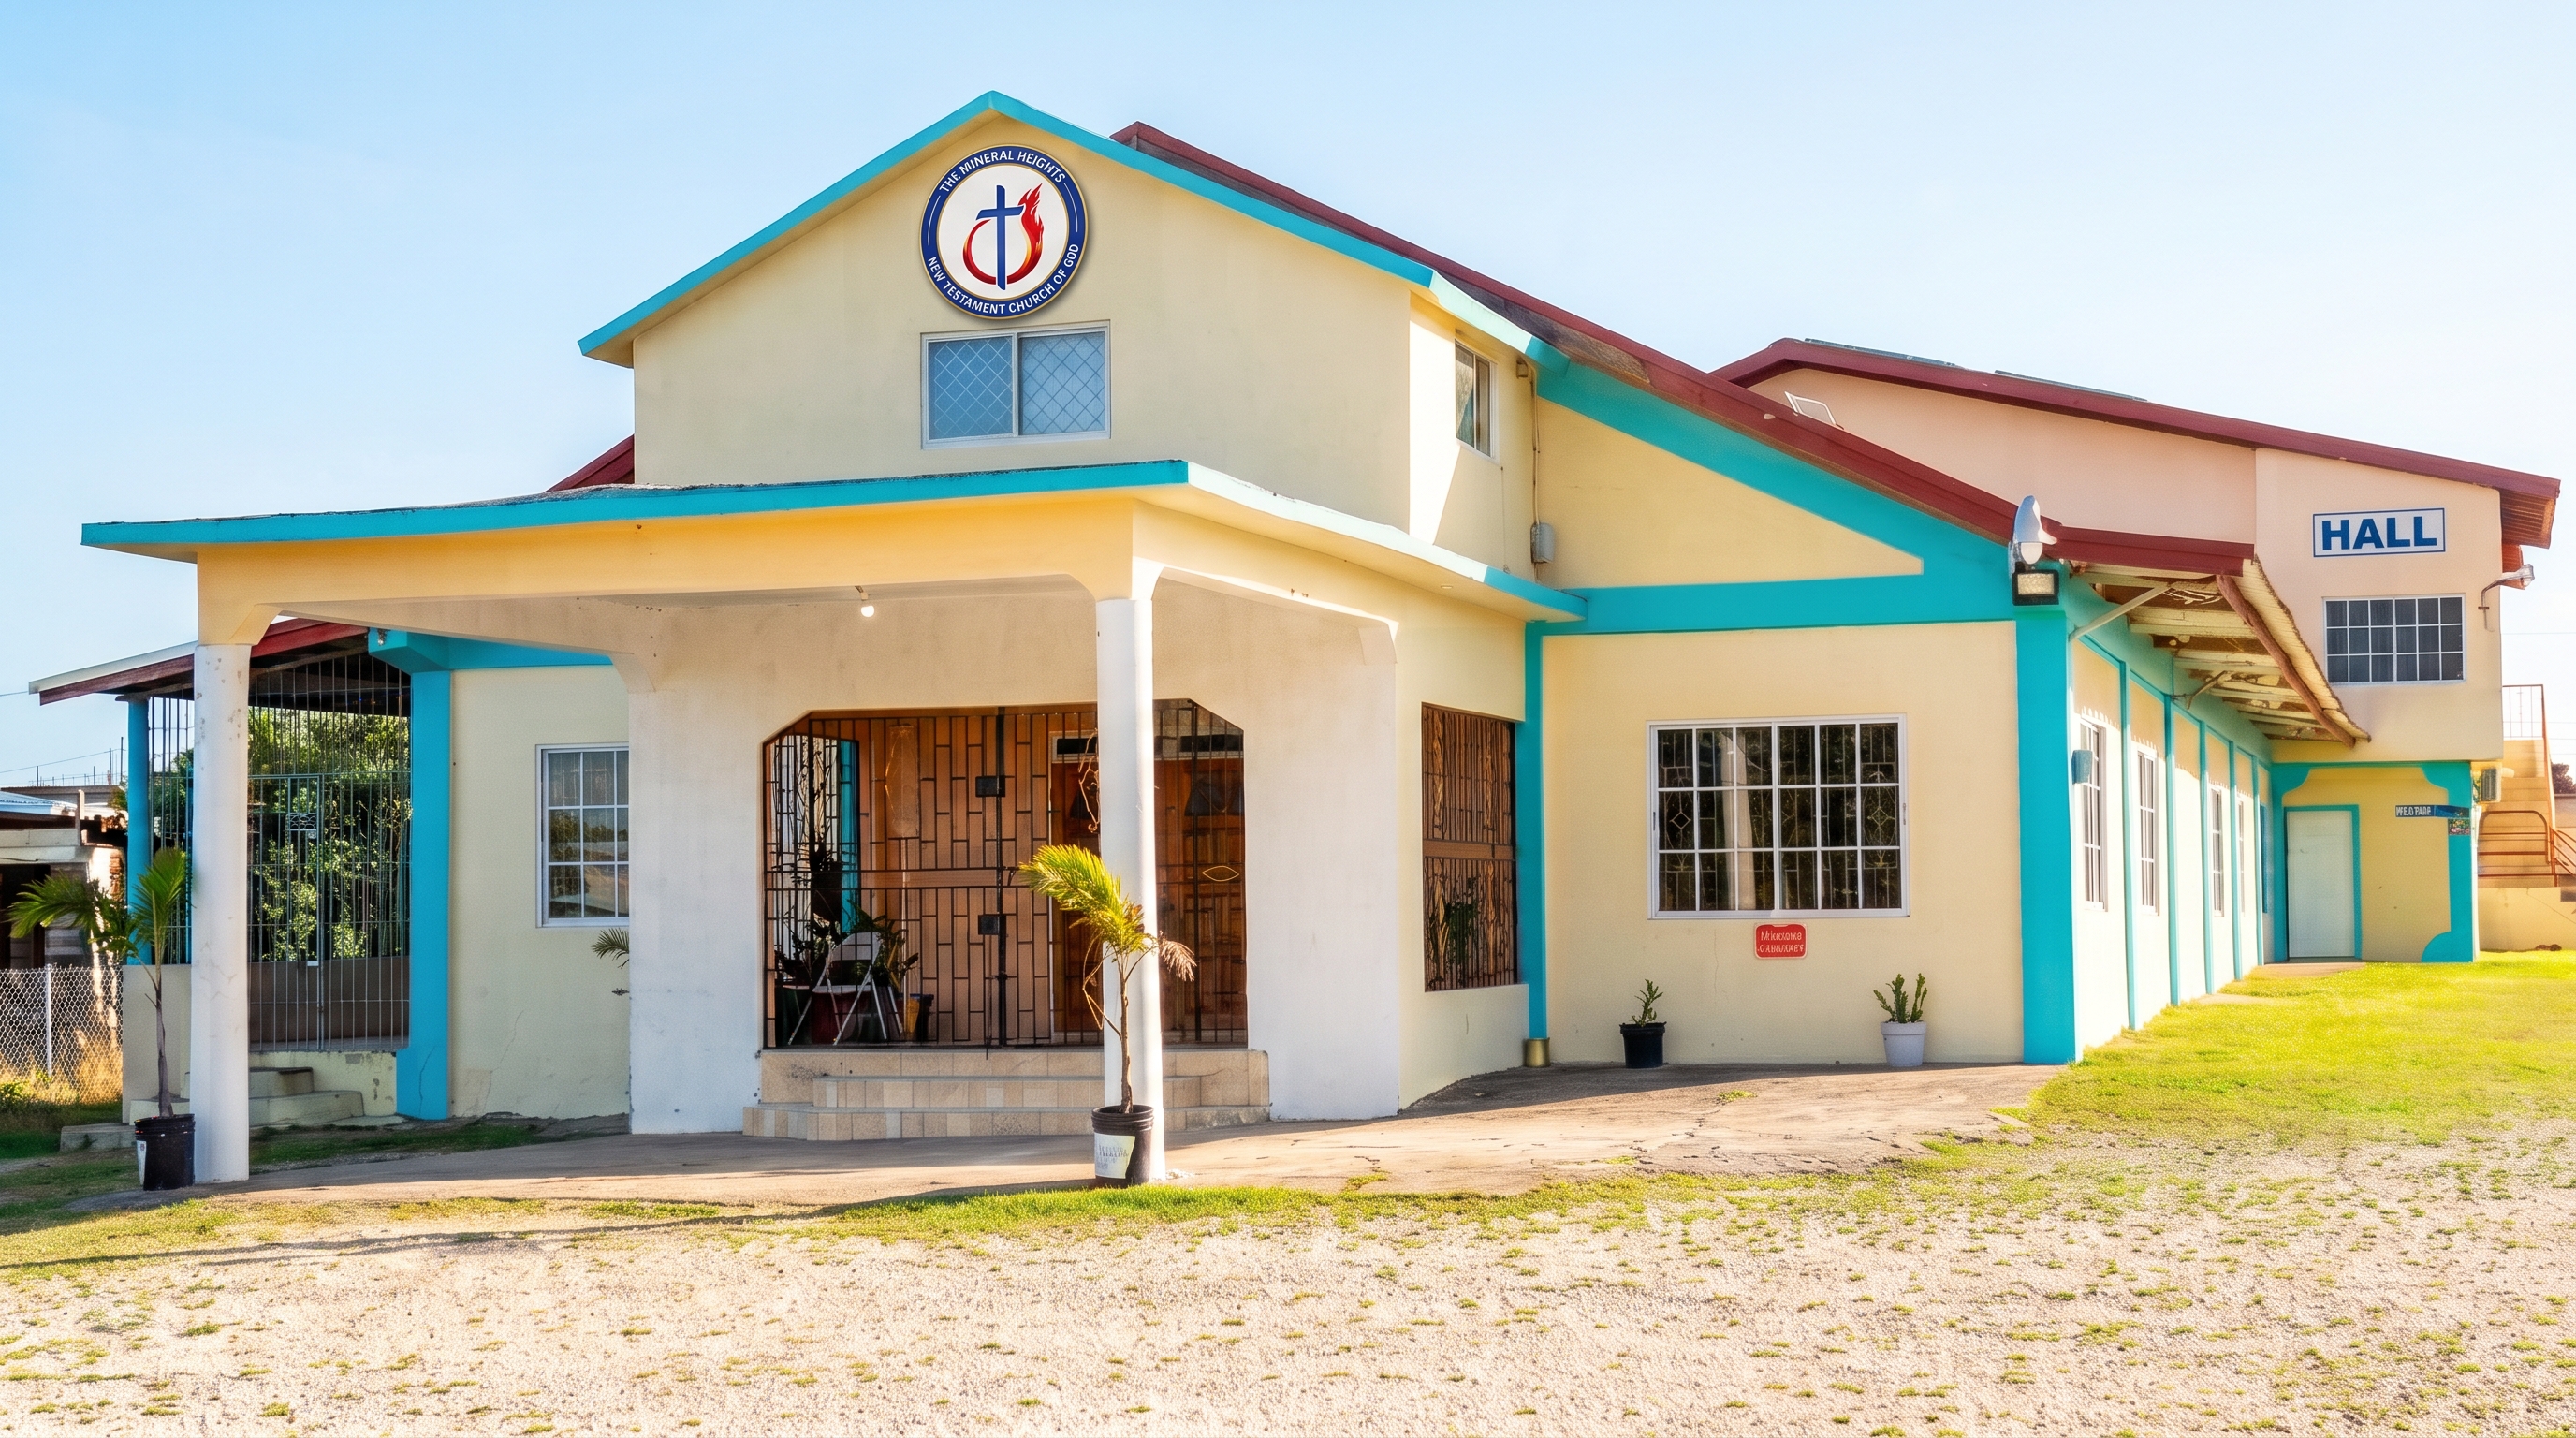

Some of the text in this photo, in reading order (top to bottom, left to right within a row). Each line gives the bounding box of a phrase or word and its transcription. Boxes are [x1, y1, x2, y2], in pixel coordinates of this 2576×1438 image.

[939, 150, 1066, 193] THE MINERAL HEIGHTS
[928, 243, 1079, 315] NEW TESTAMENT CHURCH OF GOD
[2321, 516, 2437, 550] HALL
